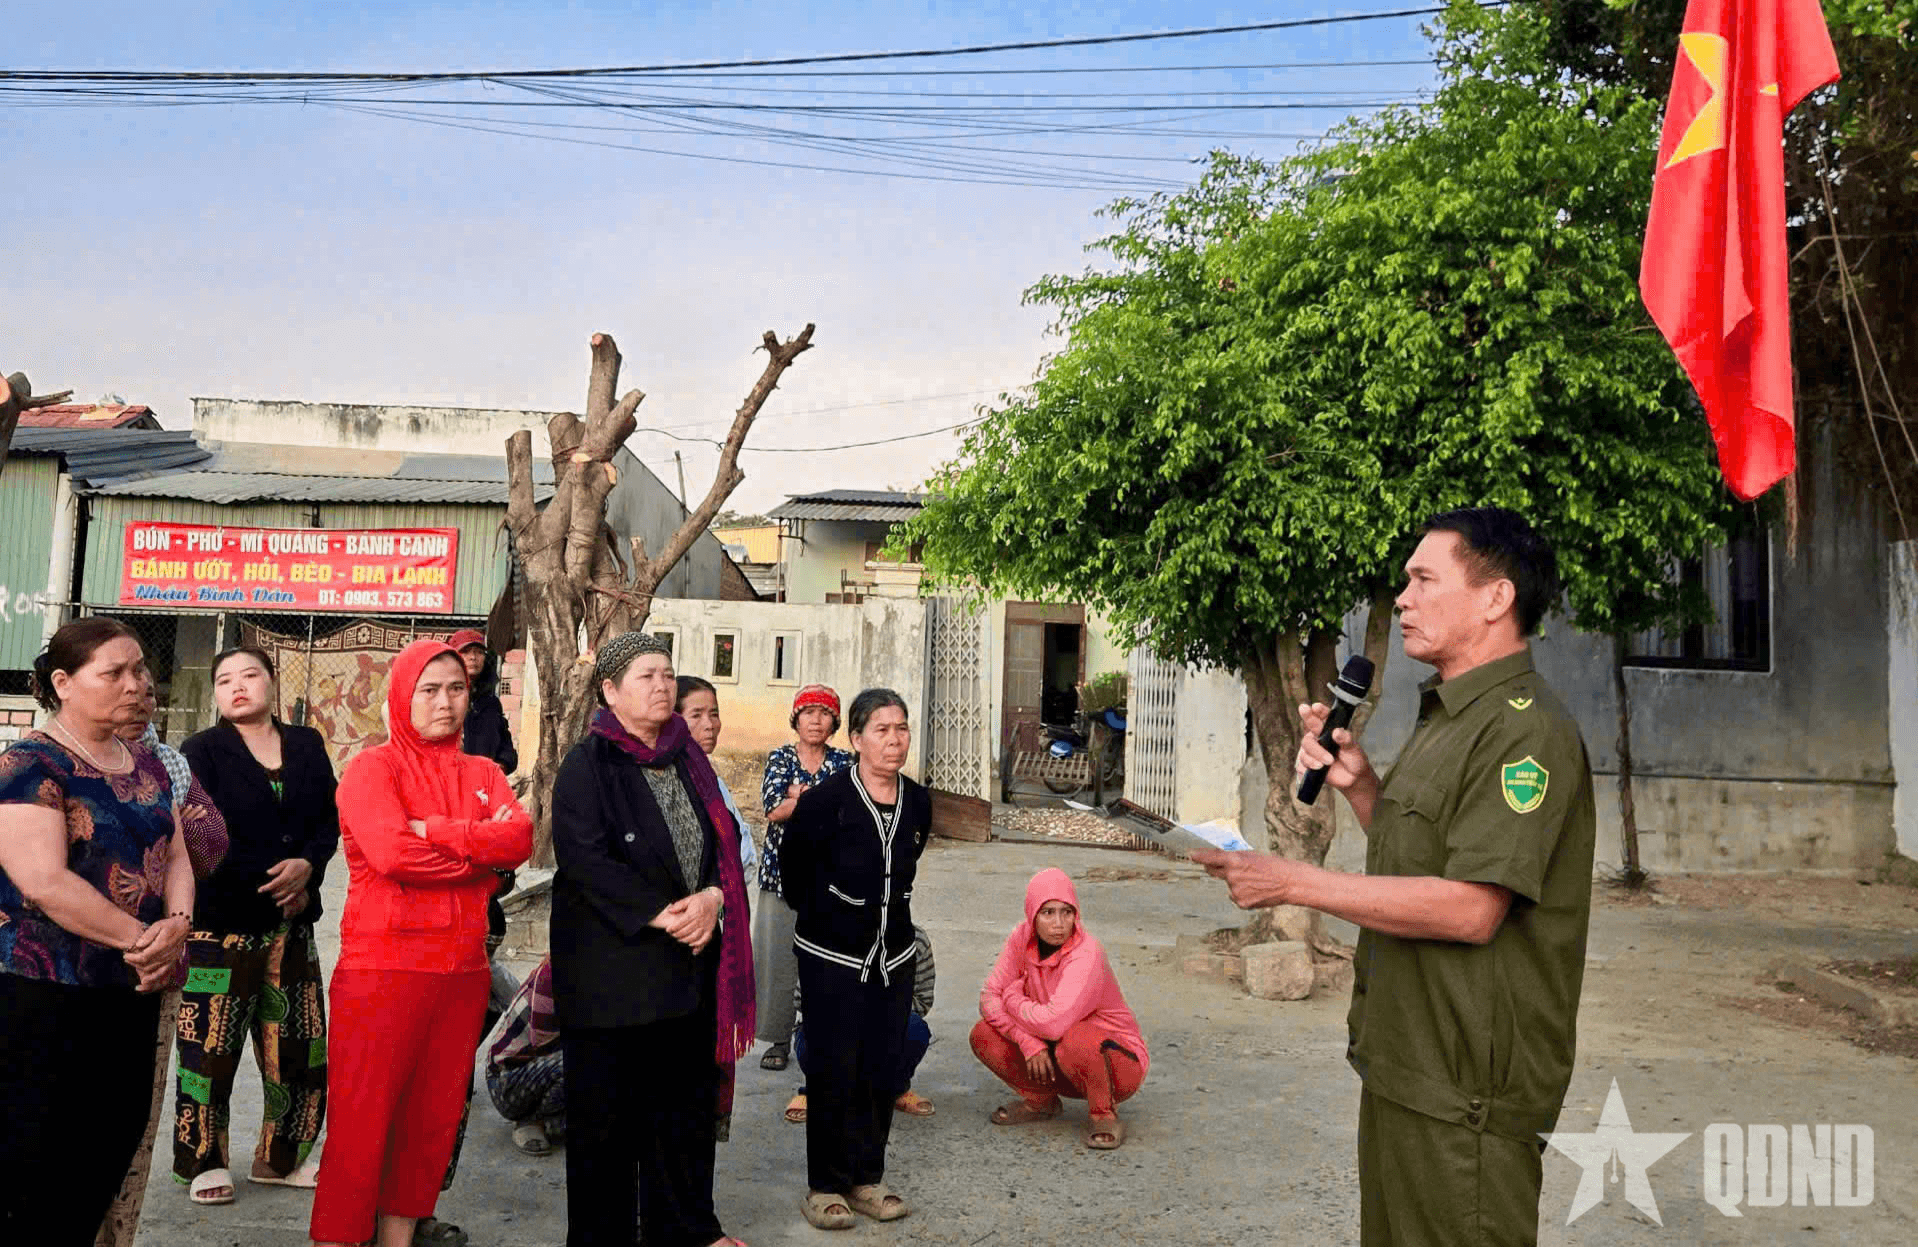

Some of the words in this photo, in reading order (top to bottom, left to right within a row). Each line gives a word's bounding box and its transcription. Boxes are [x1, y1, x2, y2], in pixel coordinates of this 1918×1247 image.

[133, 526, 170, 551] BÚN
[346, 531, 394, 556] BÁNH
[399, 535, 449, 557] CANH
[131, 557, 188, 579] BÁNH
[351, 565, 387, 585] BIA
[392, 566, 448, 588] LẠNH
[386, 591, 414, 608] 573
